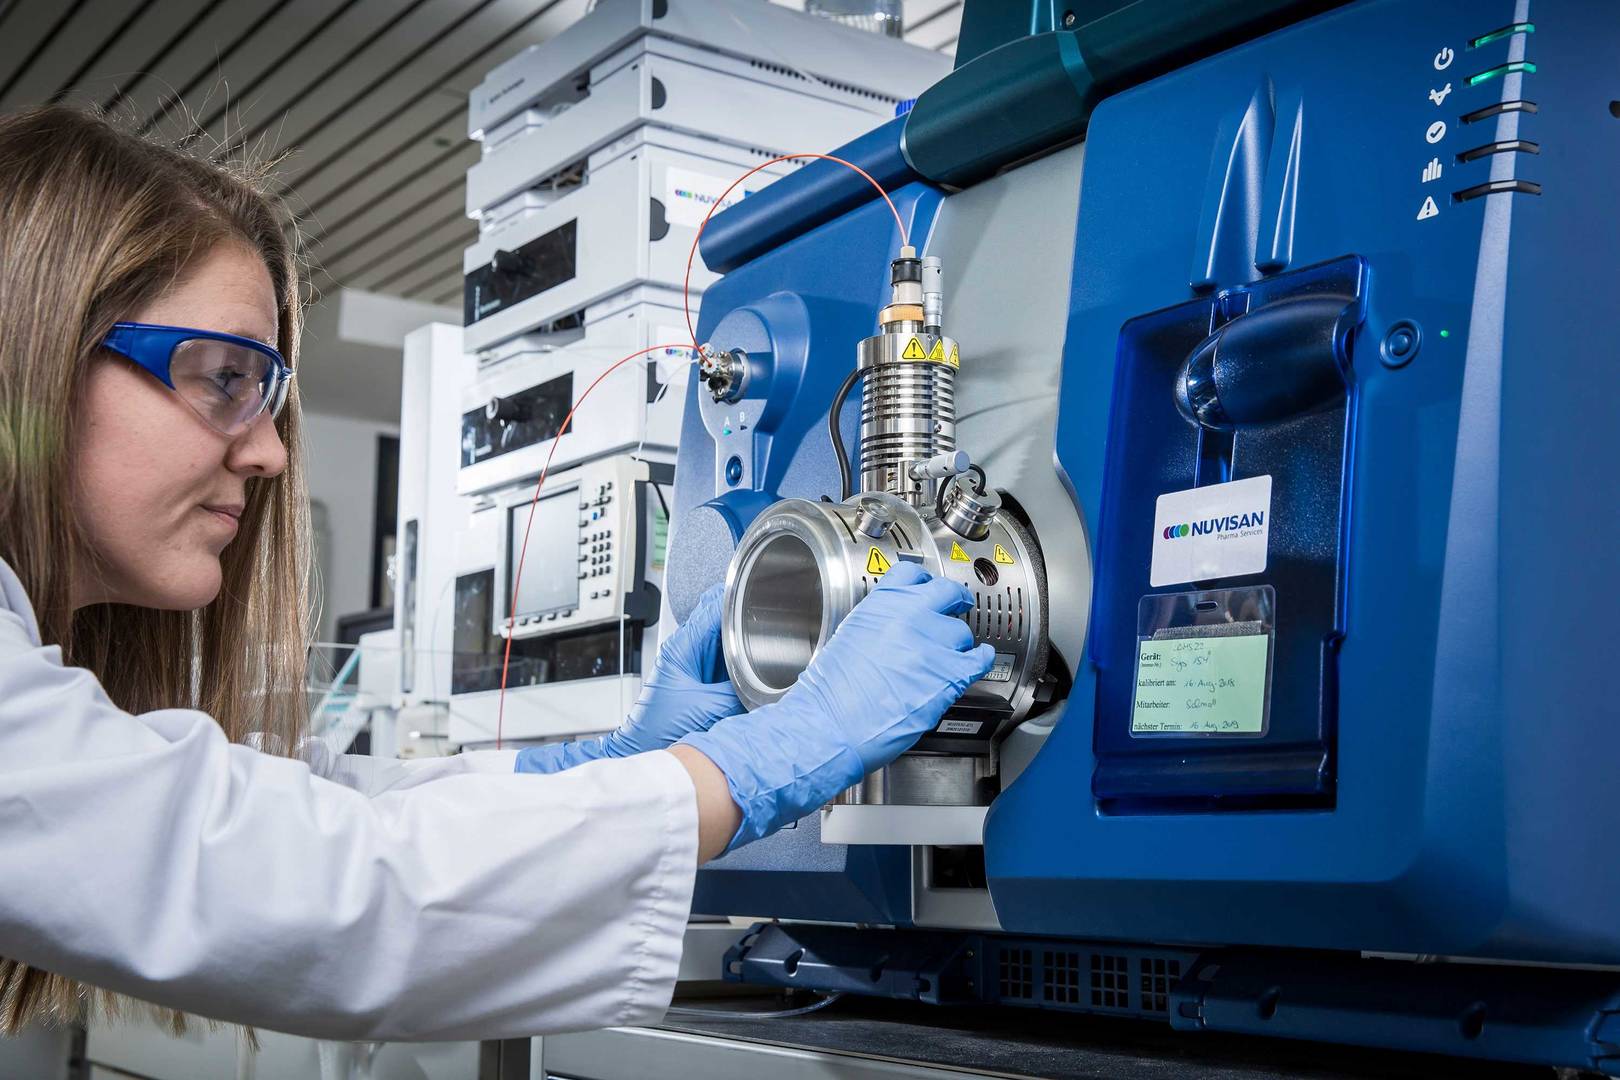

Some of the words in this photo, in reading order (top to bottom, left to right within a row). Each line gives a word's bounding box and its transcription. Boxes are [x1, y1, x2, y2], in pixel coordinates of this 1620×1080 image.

[724, 416, 731, 426] A
[1191, 511, 1264, 536] NUVISAN
[1216, 531, 1238, 541] Pharma
[1240, 528, 1263, 538] Services
[1141, 652, 1161, 661] Gerät:
[1138, 679, 1165, 687] kalibriert
[1133, 721, 1159, 730] nächster
